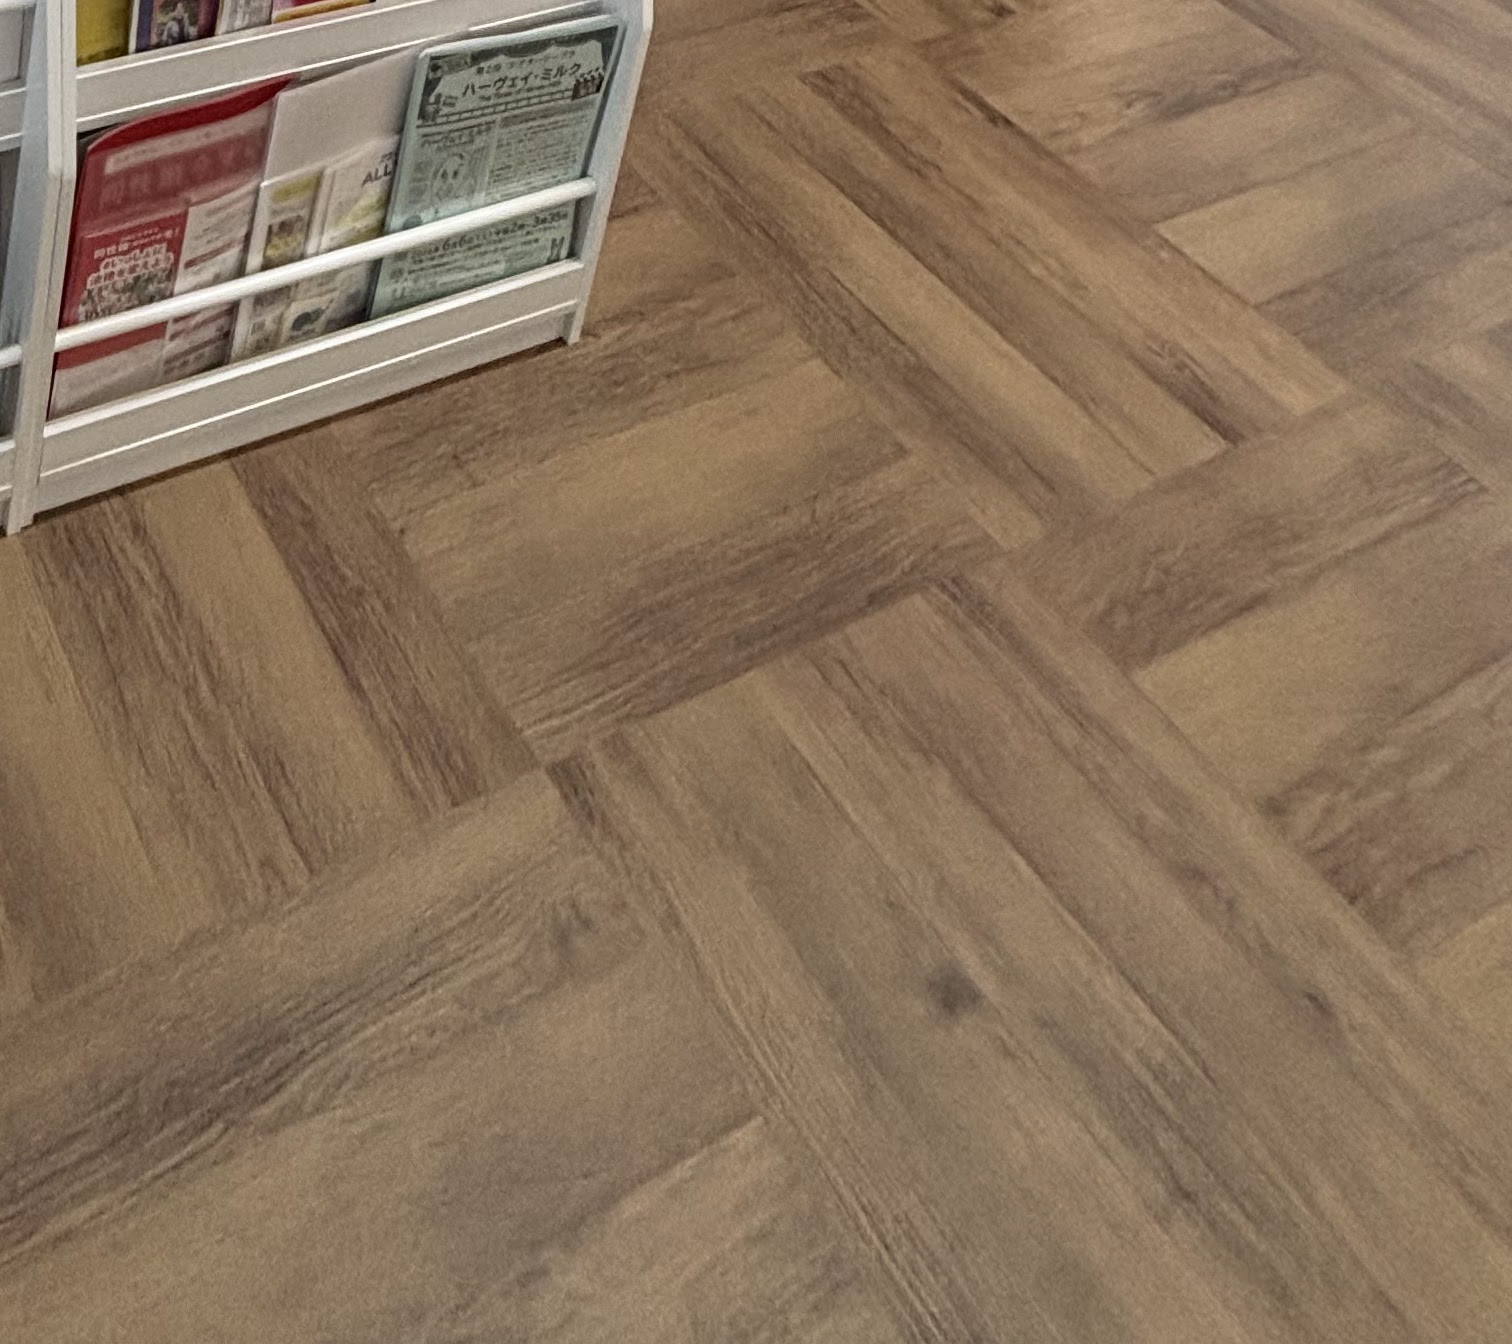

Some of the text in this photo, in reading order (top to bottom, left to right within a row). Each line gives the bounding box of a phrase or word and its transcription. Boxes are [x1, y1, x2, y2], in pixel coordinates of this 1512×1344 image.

[462, 63, 582, 97] ハーヴェイ・ミルク
